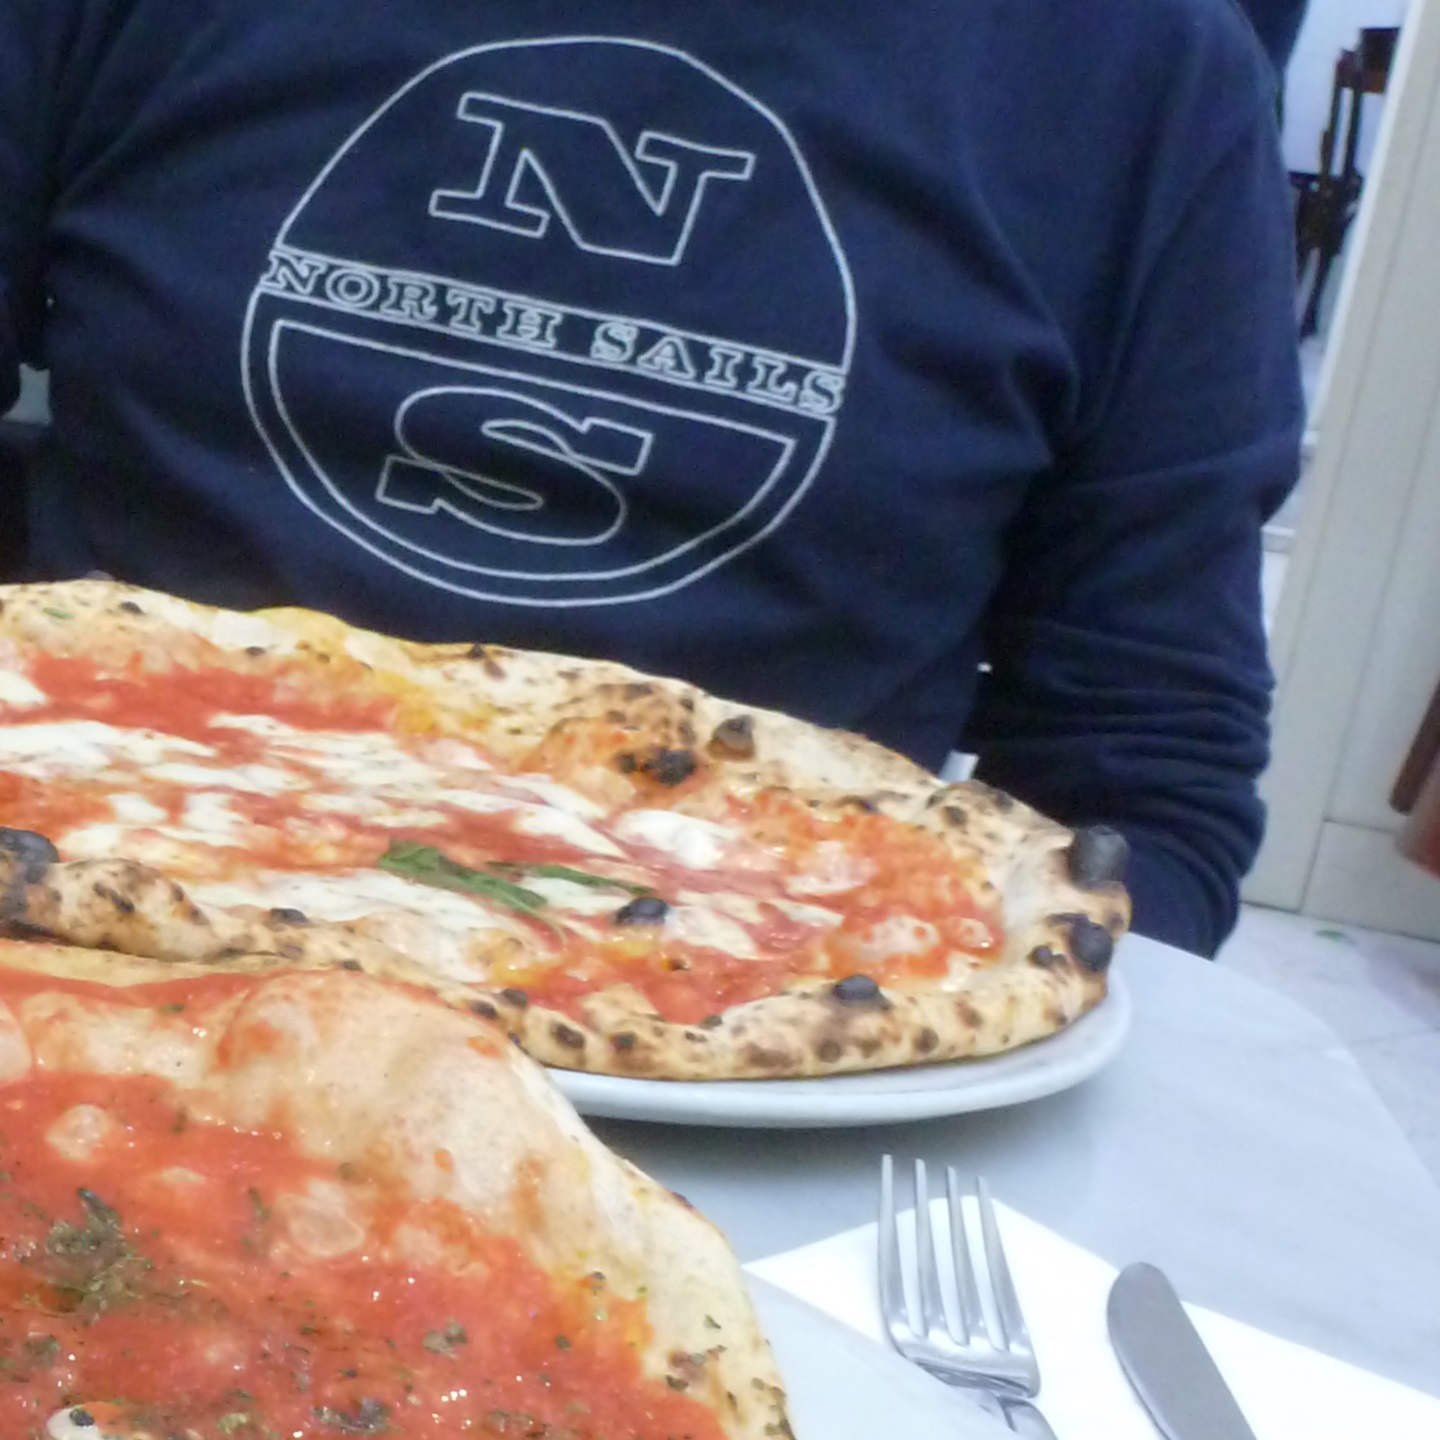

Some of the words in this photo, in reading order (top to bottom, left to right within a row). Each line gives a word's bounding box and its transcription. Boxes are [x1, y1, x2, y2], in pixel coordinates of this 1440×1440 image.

[429, 91, 755, 266] N
[263, 253, 559, 350] NORTH
[590, 319, 846, 414] SAILS
[375, 386, 653, 546] S
